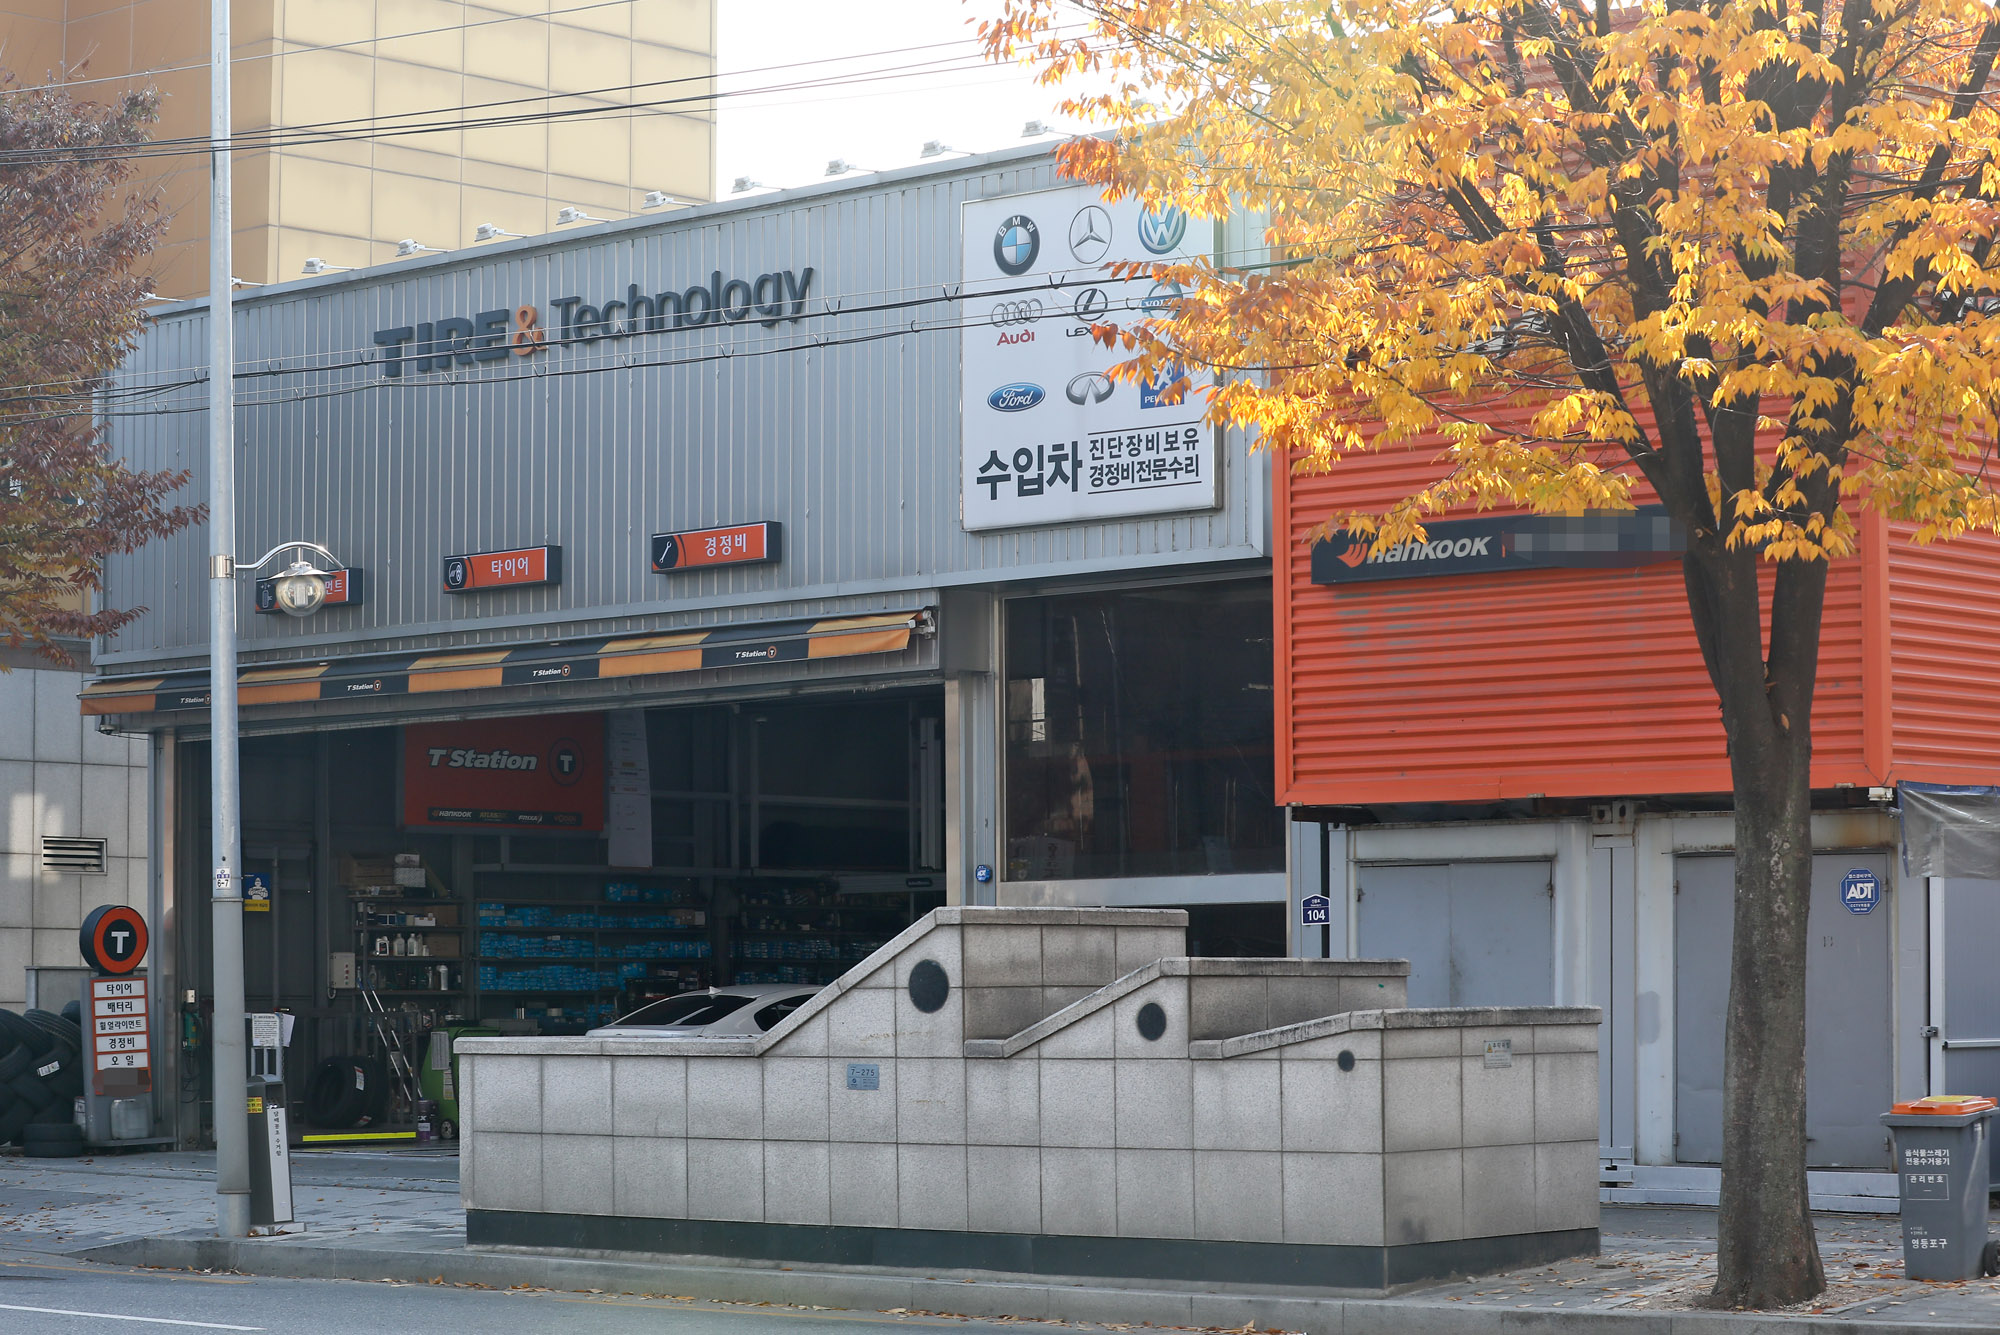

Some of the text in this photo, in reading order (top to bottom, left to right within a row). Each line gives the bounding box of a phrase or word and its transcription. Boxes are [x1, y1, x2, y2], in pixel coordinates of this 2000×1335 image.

[998, 216, 1036, 237] BMW
[373, 266, 814, 378] TIRE & Technology
[997, 330, 1035, 346] Audi
[998, 389, 1034, 407] Ford
[976, 440, 1083, 500] 수입차
[704, 533, 748, 557] 경정비
[491, 557, 530, 579] 타이어
[448, 749, 538, 771] Station
[560, 755, 573, 772] T
[1846, 883, 1875, 899] ADT
[1307, 909, 1326, 921] 104
[111, 931, 130, 954] T
[106, 983, 132, 995] 타이어
[107, 1001, 133, 1013] 배터리
[108, 1037, 135, 1049] 경정비
[1905, 1149, 1950, 1157] 음식물쓰레기
[1905, 1157, 1950, 1166] 전용수거용기
[1911, 1238, 1948, 1249] 영등포구
